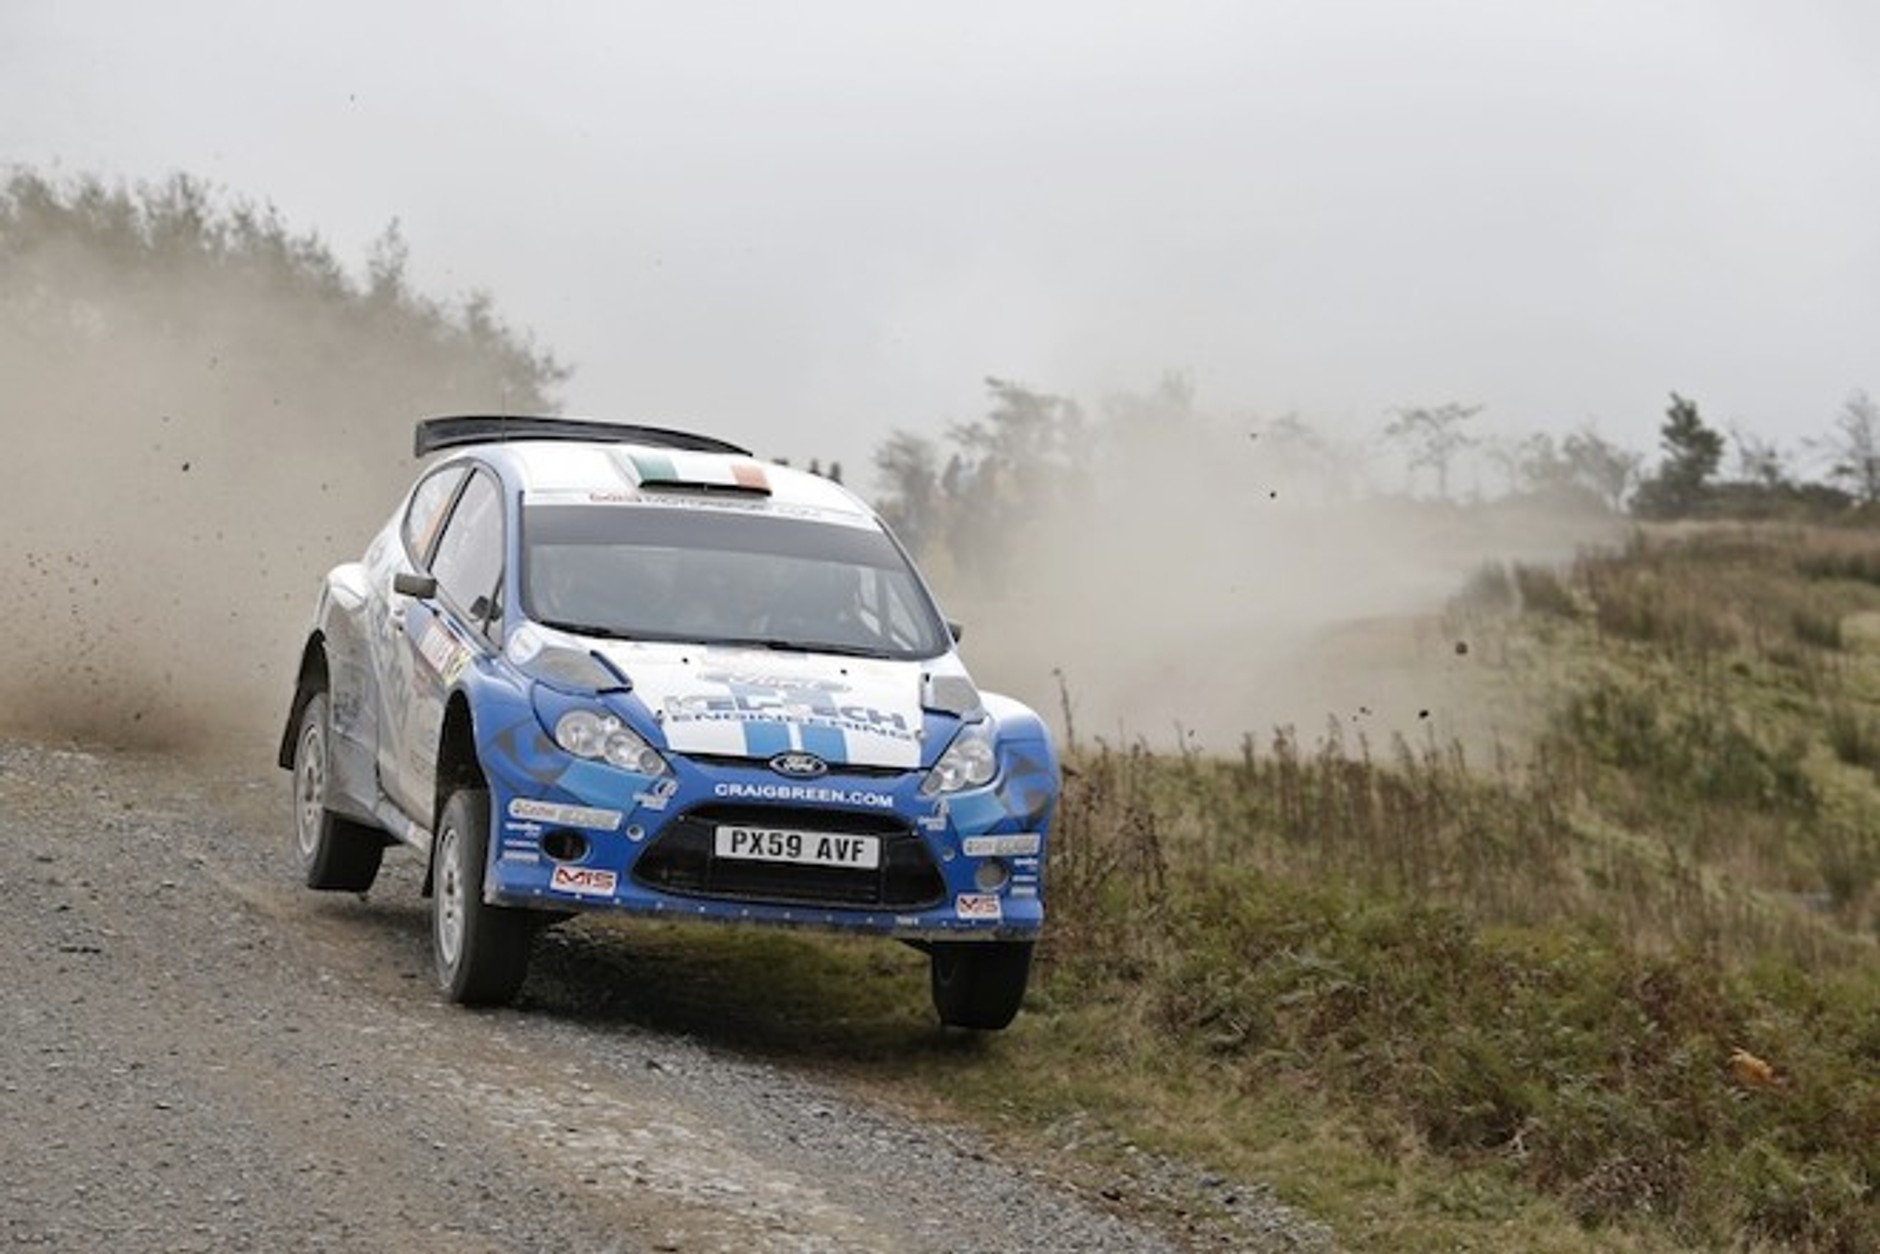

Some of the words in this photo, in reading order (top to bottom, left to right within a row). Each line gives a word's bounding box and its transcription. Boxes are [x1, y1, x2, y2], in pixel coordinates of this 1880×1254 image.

[714, 783, 894, 808] CRAIGBREEN.COM
[730, 830, 802, 858] PX59
[816, 838, 865, 862] AVF
